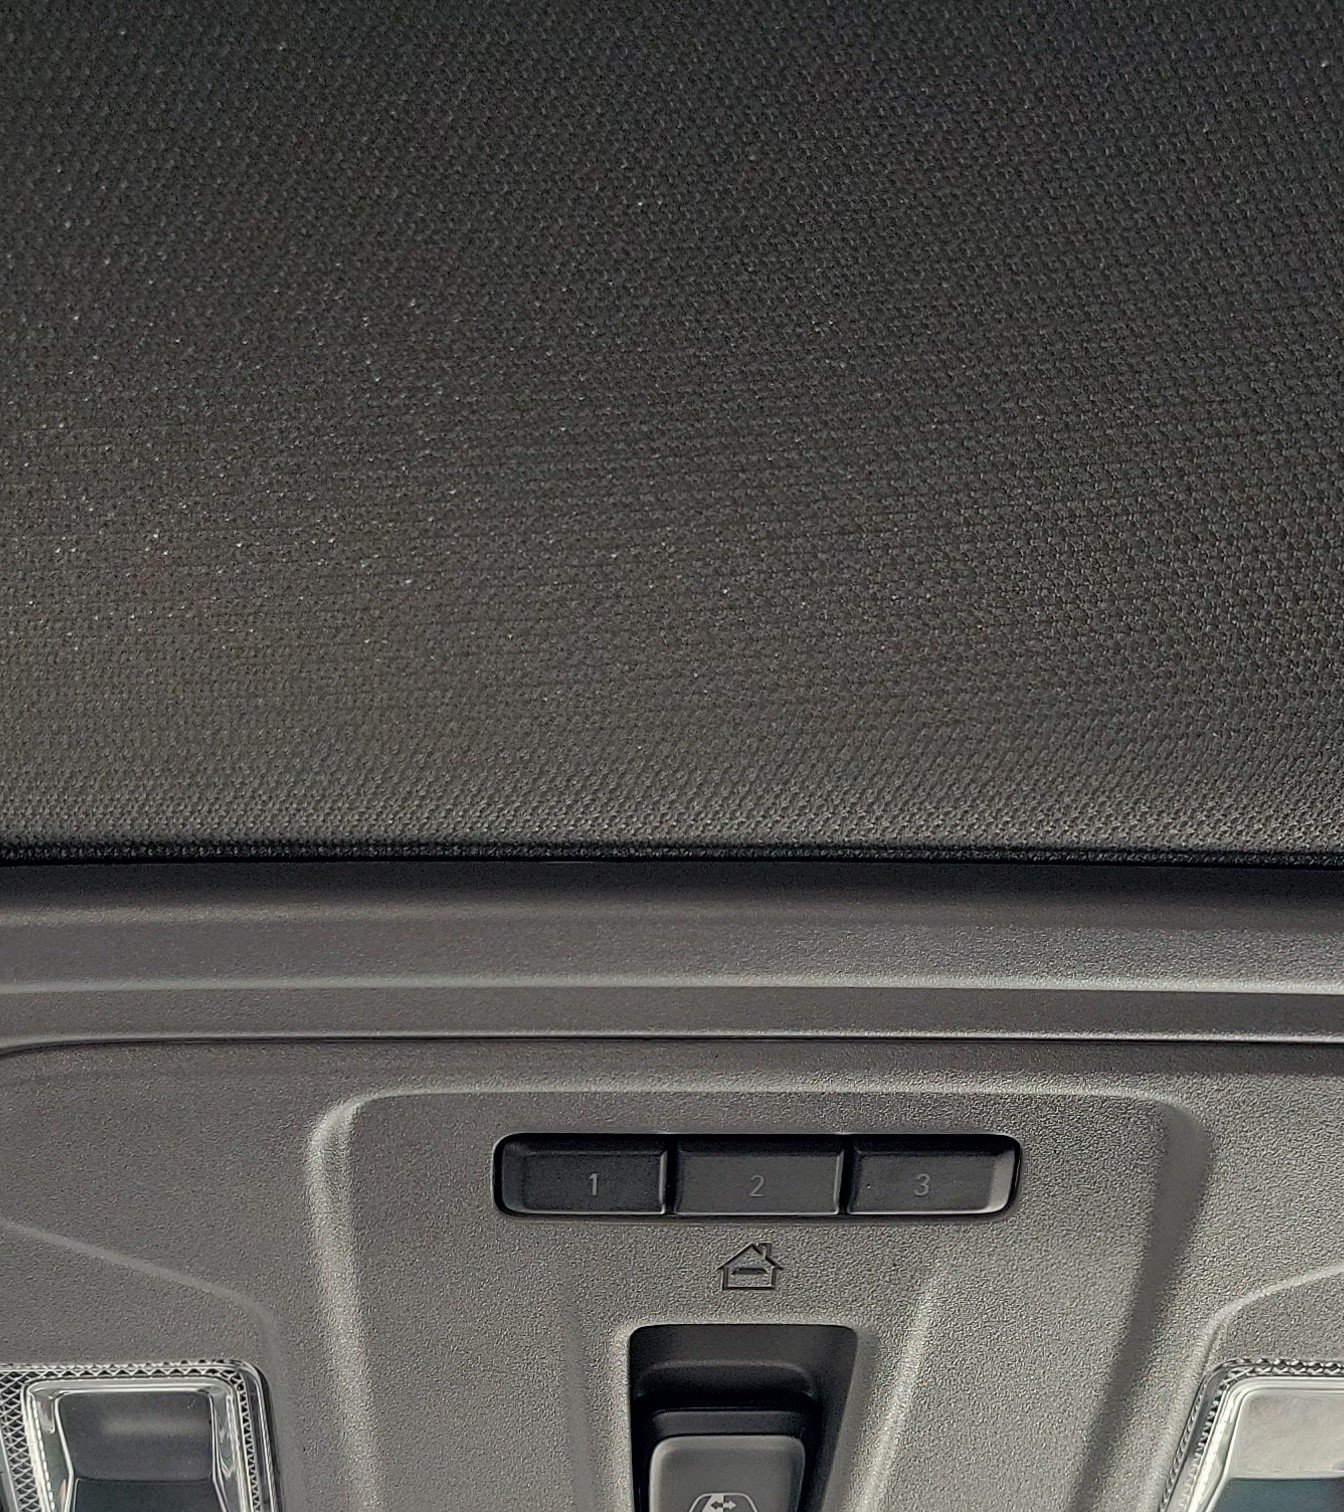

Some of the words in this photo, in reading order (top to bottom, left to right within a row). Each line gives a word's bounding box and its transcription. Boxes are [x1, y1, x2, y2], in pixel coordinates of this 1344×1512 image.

[586, 1173, 599, 1196] 1
[749, 1175, 765, 1197] 2
[913, 1174, 929, 1196] 3
